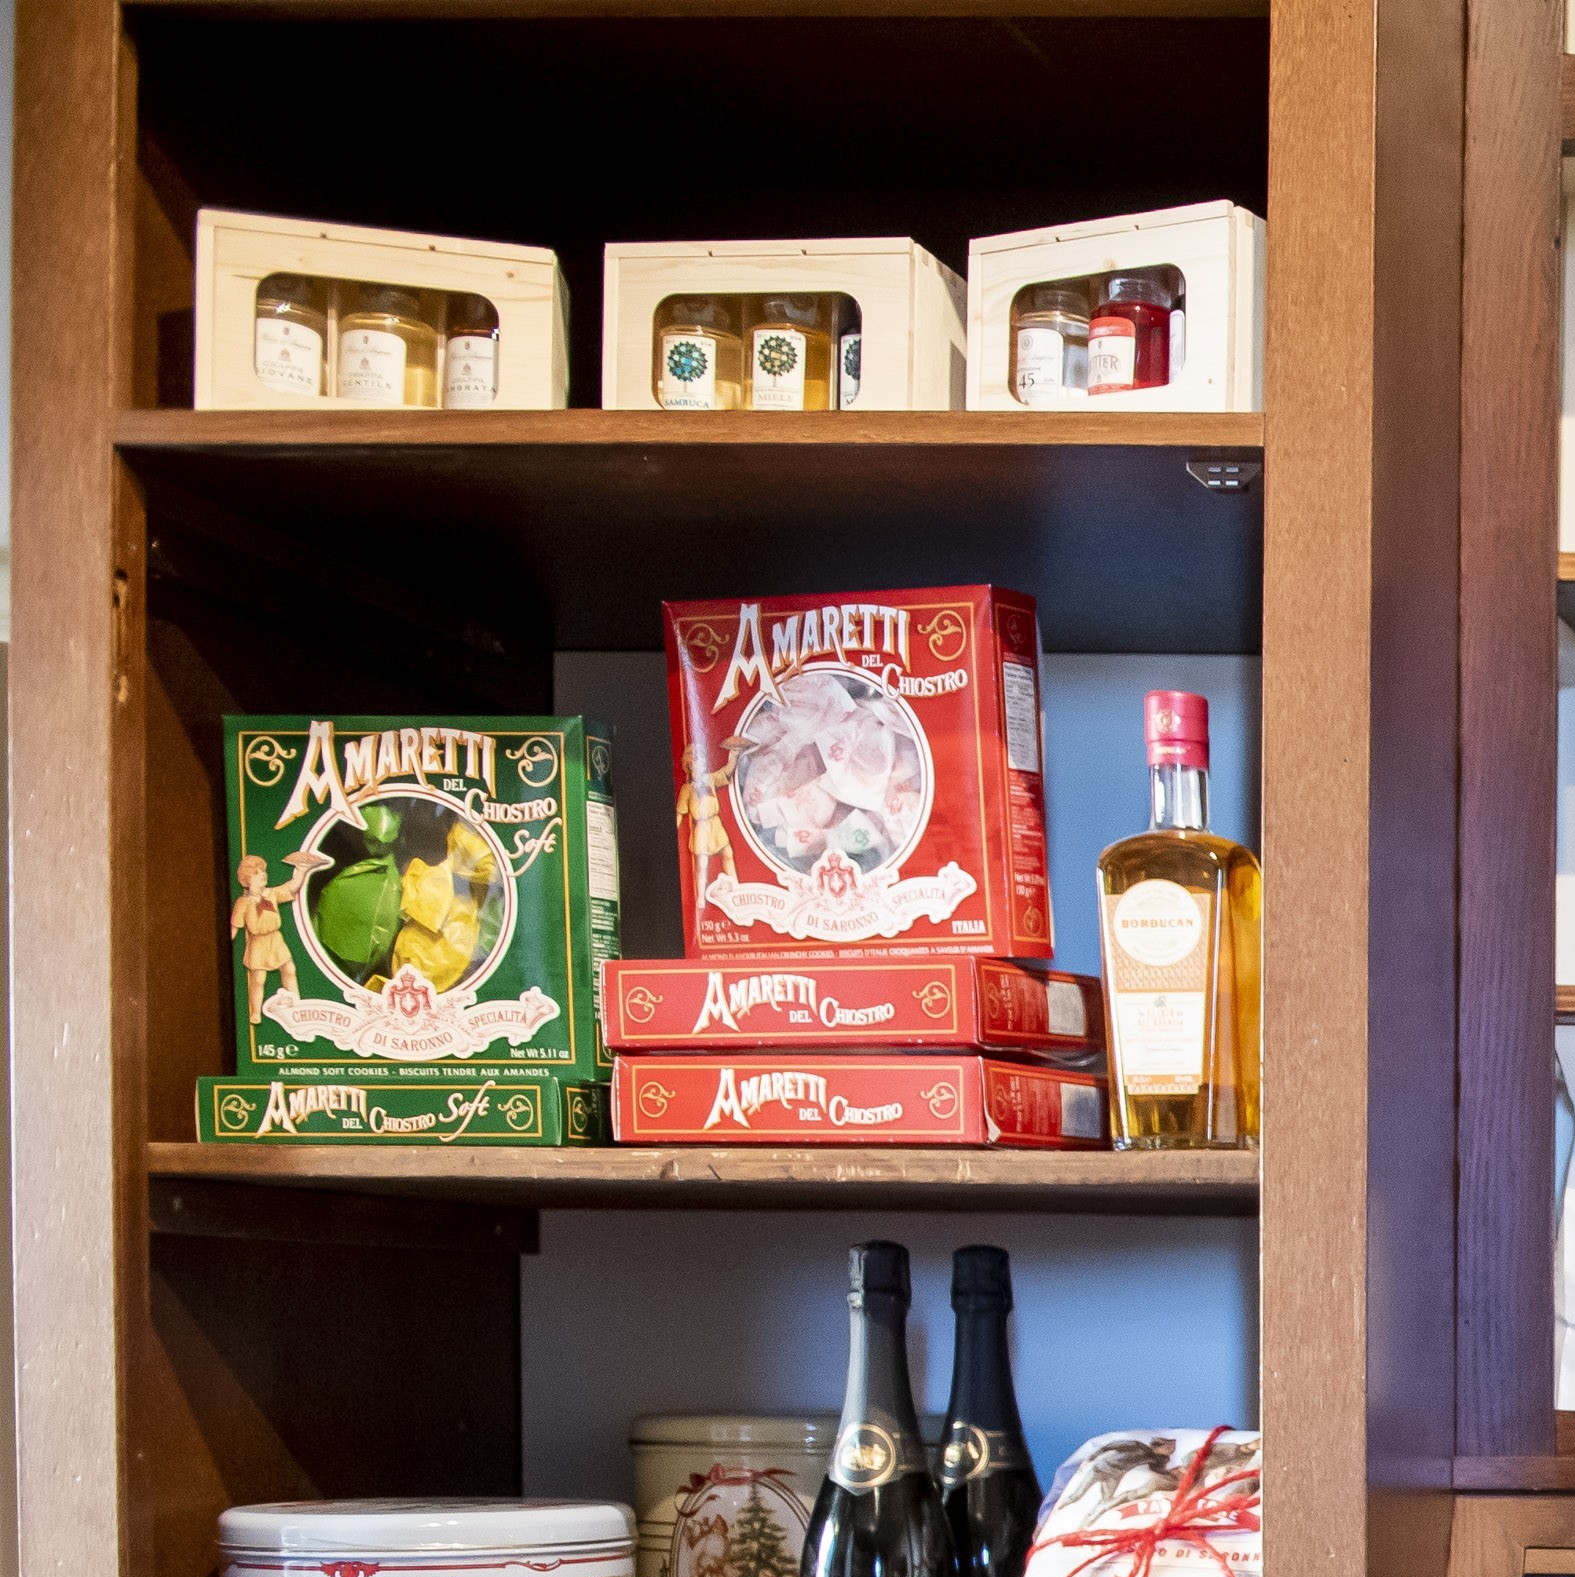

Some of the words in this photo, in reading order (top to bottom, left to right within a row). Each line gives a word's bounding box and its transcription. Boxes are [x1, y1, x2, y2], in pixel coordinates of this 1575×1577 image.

[663, 398, 710, 409] SAMBUCA
[711, 603, 910, 712] AMARETTI
[862, 655, 883, 667] DEL
[881, 664, 968, 697] CHIOSTRO
[274, 720, 497, 830] AMARETTI
[443, 778, 467, 792] DEL
[464, 789, 558, 825] CHIOSTRO
[504, 818, 562, 877] Soft
[732, 891, 785, 911] CHIOSTRO
[806, 914, 819, 927] DI
[822, 910, 878, 934] SARONNO
[951, 920, 985, 934] ITALIA
[1121, 918, 1193, 927] BORDUCAN
[692, 971, 816, 1035] AMARETTI
[789, 1011, 812, 1024] DEL
[819, 996, 895, 1026] CHIOSTRO
[291, 1010, 352, 1028] CHIOSTRO
[258, 1043, 275, 1057] 145
[277, 1047, 284, 1060] g
[373, 1033, 387, 1046] DI
[390, 1031, 454, 1051] SARONNO
[511, 1047, 525, 1057] Net
[527, 1048, 538, 1057] Wt
[539, 1048, 557, 1058] 5.11
[559, 1050, 569, 1059] oz
[279, 1067, 320, 1076] ALMOND
[323, 1067, 345, 1076] SOFT
[348, 1067, 388, 1076] COOKIES
[400, 1067, 439, 1076] BISCUITS
[442, 1067, 476, 1076] TENDRE
[480, 1068, 500, 1076] AUX
[503, 1068, 549, 1076] AMANDES
[257, 1082, 367, 1138] AMARETTI
[704, 1067, 827, 1130] AMARETTI
[799, 1108, 821, 1121] DEL
[828, 1095, 902, 1126] CHIOSTRO
[342, 1118, 362, 1128] DEL
[369, 1107, 436, 1132] CHIOSTRO
[439, 1081, 496, 1142] Soft
